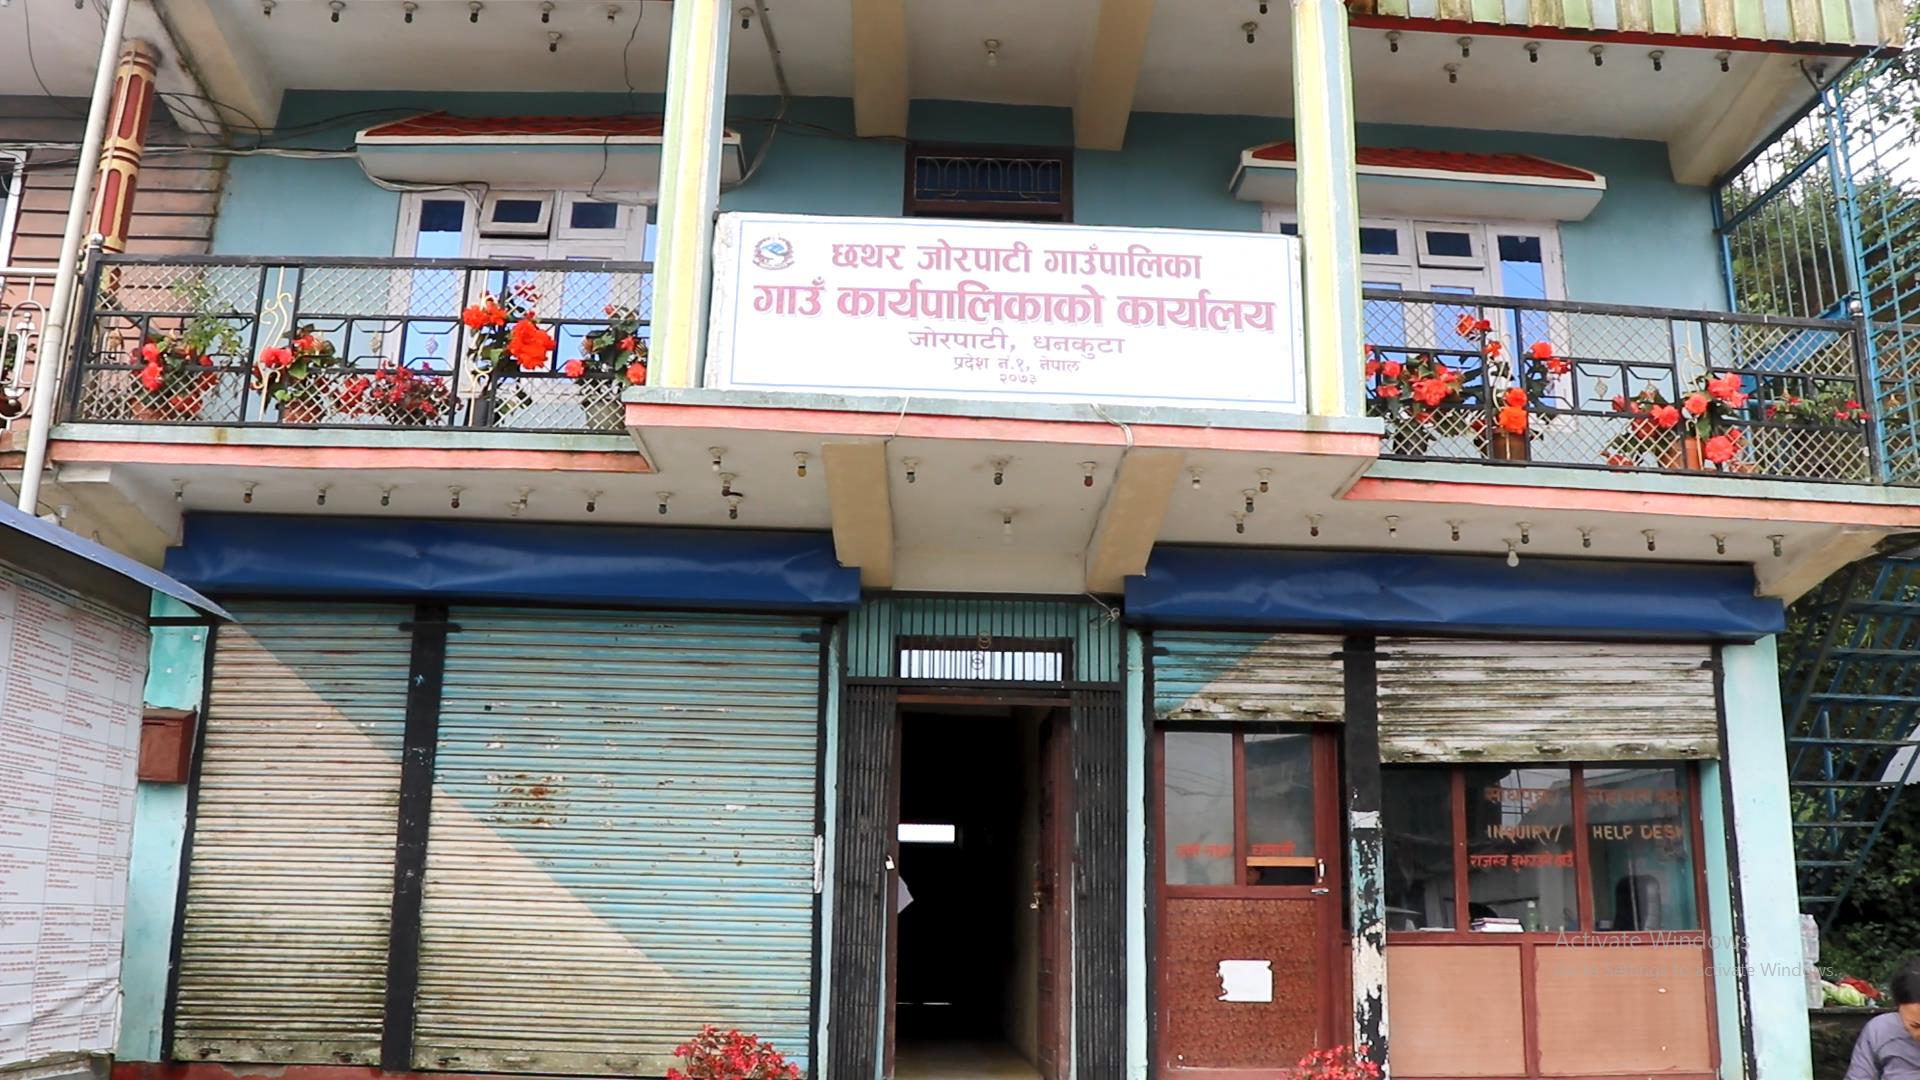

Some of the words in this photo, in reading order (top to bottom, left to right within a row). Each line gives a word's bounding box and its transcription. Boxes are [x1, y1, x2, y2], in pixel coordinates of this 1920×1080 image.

[832, 243, 906, 270] छथर
[917, 238, 1033, 273] जोरपाटी
[1044, 243, 1203, 279] गाउँपालिका
[753, 276, 826, 318] गाउँ
[837, 278, 1105, 325] कार्यपालिकाको
[1117, 288, 1277, 333] कार्यालय
[908, 327, 1016, 353] जोरपाटी,
[1033, 335, 1126, 360] धनकुटा
[953, 353, 990, 371] प्रदेश
[1040, 355, 1081, 372] नेपाल
[1000, 373, 1037, 384] २०७३
[1593, 825, 1633, 840] HELP
